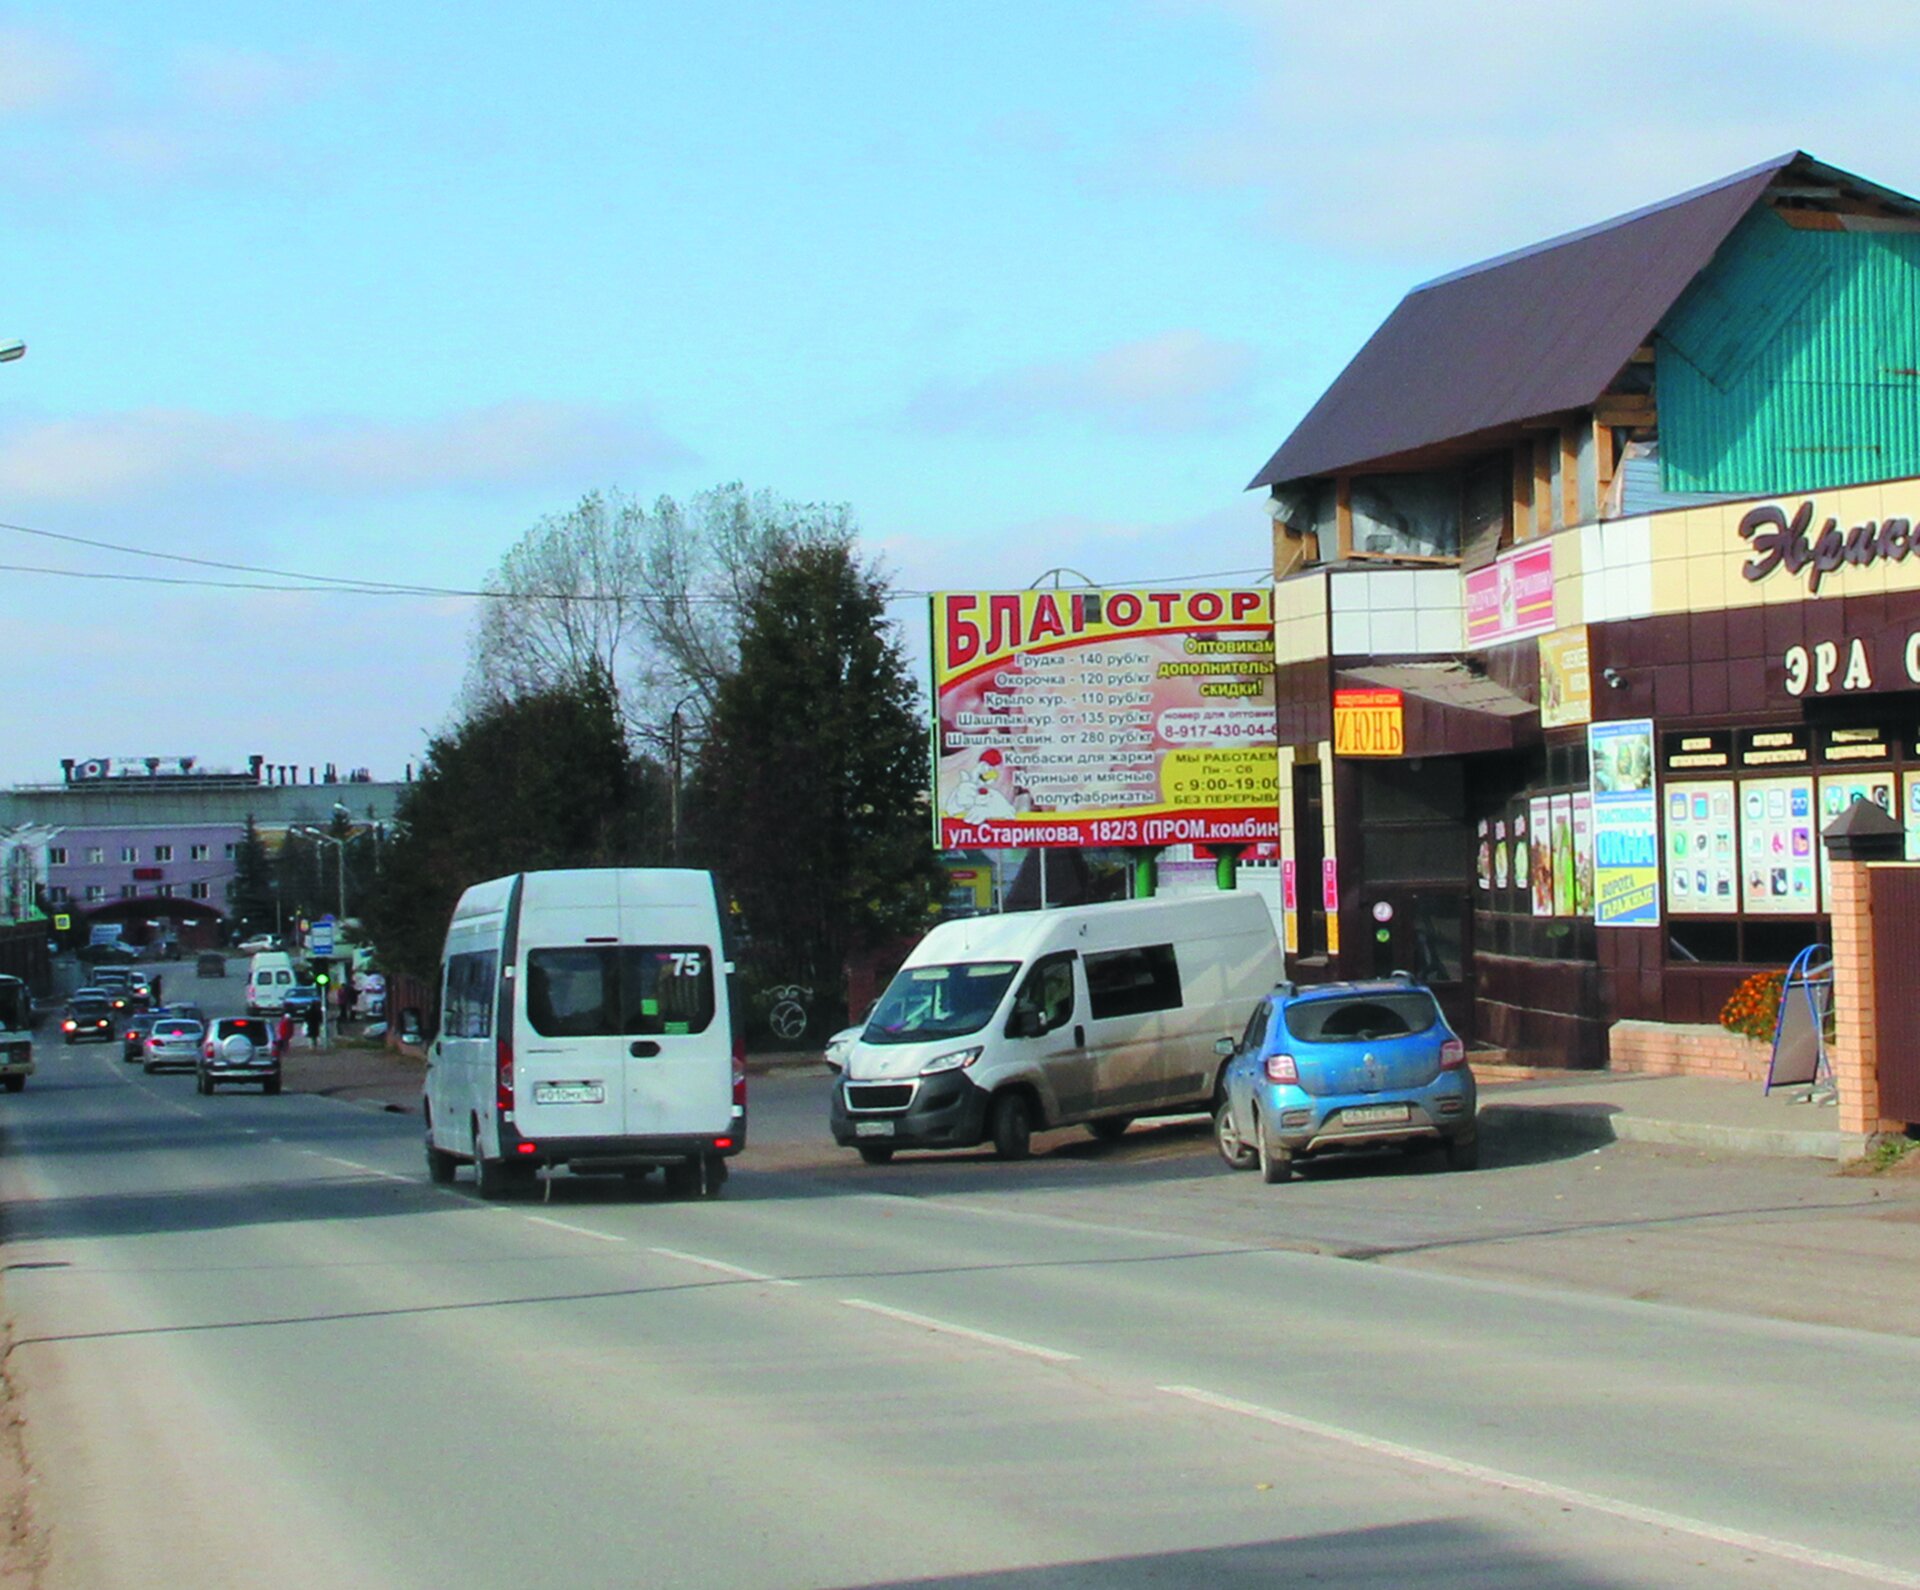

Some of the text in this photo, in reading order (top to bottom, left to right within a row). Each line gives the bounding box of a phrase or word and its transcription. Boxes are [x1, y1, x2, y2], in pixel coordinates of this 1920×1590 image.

[946, 592, 1275, 670] БЛАГОТОР
[1015, 654, 1065, 667] Грудка
[1081, 653, 1102, 664] 140
[1107, 653, 1150, 667] руб/кг
[1785, 638, 1872, 696] ЭРА
[996, 674, 1065, 686] Окорочка
[1081, 673, 1103, 684] 120
[1108, 673, 1150, 686] руб/кг
[1200, 681, 1264, 698] скидки!
[986, 694, 1034, 706] Крыло
[1038, 696, 1067, 706] кур.
[1082, 693, 1103, 704] 110
[1108, 693, 1150, 706] руб/кг
[958, 713, 1151, 727] Шашлык кур. от 135 руб/кг
[1164, 711, 1200, 720] номер
[1203, 711, 1224, 720] для
[1336, 711, 1400, 751] ИЮНЬ
[947, 732, 1151, 746] Шашлык свин. от 280 руб/кг
[1004, 752, 1153, 764] Колбаски для жарки
[1176, 753, 1200, 763] МЫ
[1014, 772, 1154, 786] Куриные и мясные
[1174, 781, 1183, 791] с
[1036, 791, 1154, 804] полуфабрикаты
[1174, 794, 1200, 804] БЕЗ
[1090, 820, 1138, 842] 182/3
[670, 953, 701, 977] 75
